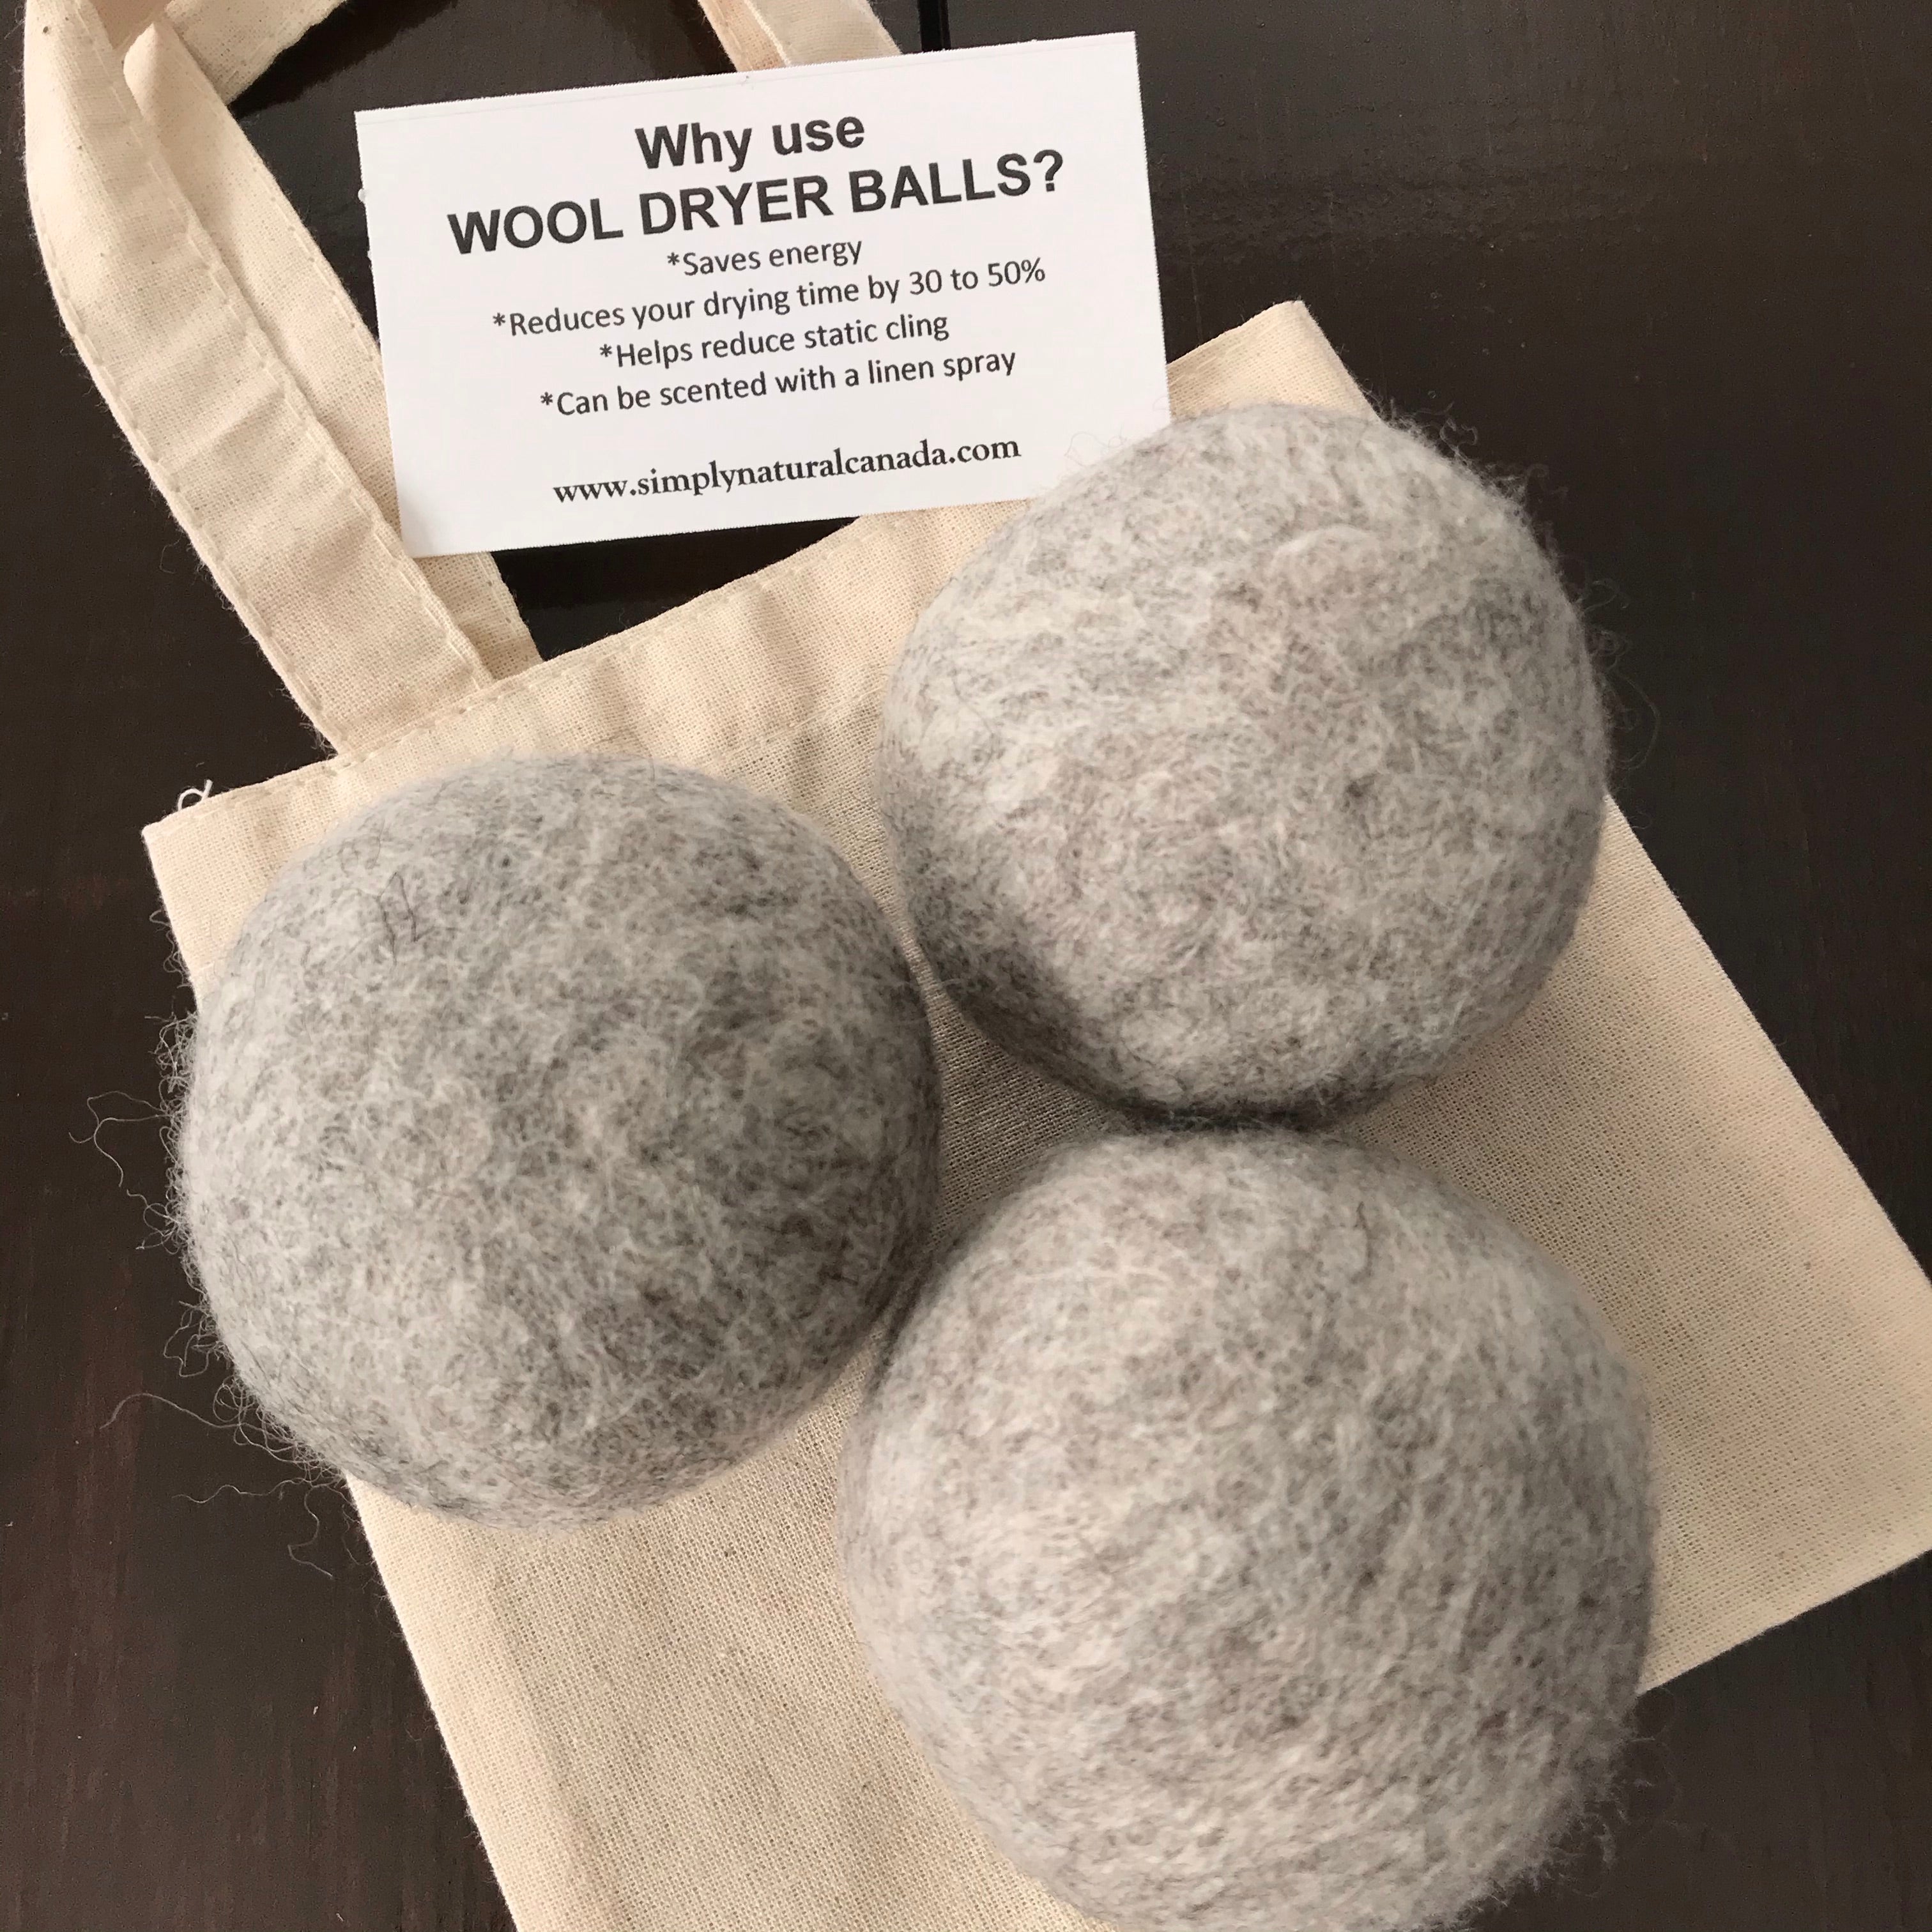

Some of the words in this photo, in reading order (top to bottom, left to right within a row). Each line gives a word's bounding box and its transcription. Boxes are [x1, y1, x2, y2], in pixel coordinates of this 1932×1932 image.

[634, 122, 752, 172] Why
[772, 116, 864, 156] use
[447, 198, 624, 255] WOOL
[639, 175, 834, 235] DRYER
[848, 149, 1063, 213] BALLS?
[769, 241, 862, 267] energy
[631, 300, 695, 330] your
[703, 288, 790, 319] drying
[796, 281, 859, 307] time
[868, 275, 900, 304] by
[909, 269, 942, 295] 30
[950, 269, 979, 291] to
[988, 257, 1045, 287] 50%
[702, 330, 795, 359] reduce
[804, 319, 878, 349] static
[885, 314, 949, 342] cling
[617, 385, 650, 410] be
[660, 371, 767, 406] scented
[774, 365, 836, 393] with
[845, 369, 859, 387] a
[868, 360, 934, 384] linen
[943, 352, 1016, 381] spray
[553, 438, 1022, 503] www.simplynaturalcanada.com
